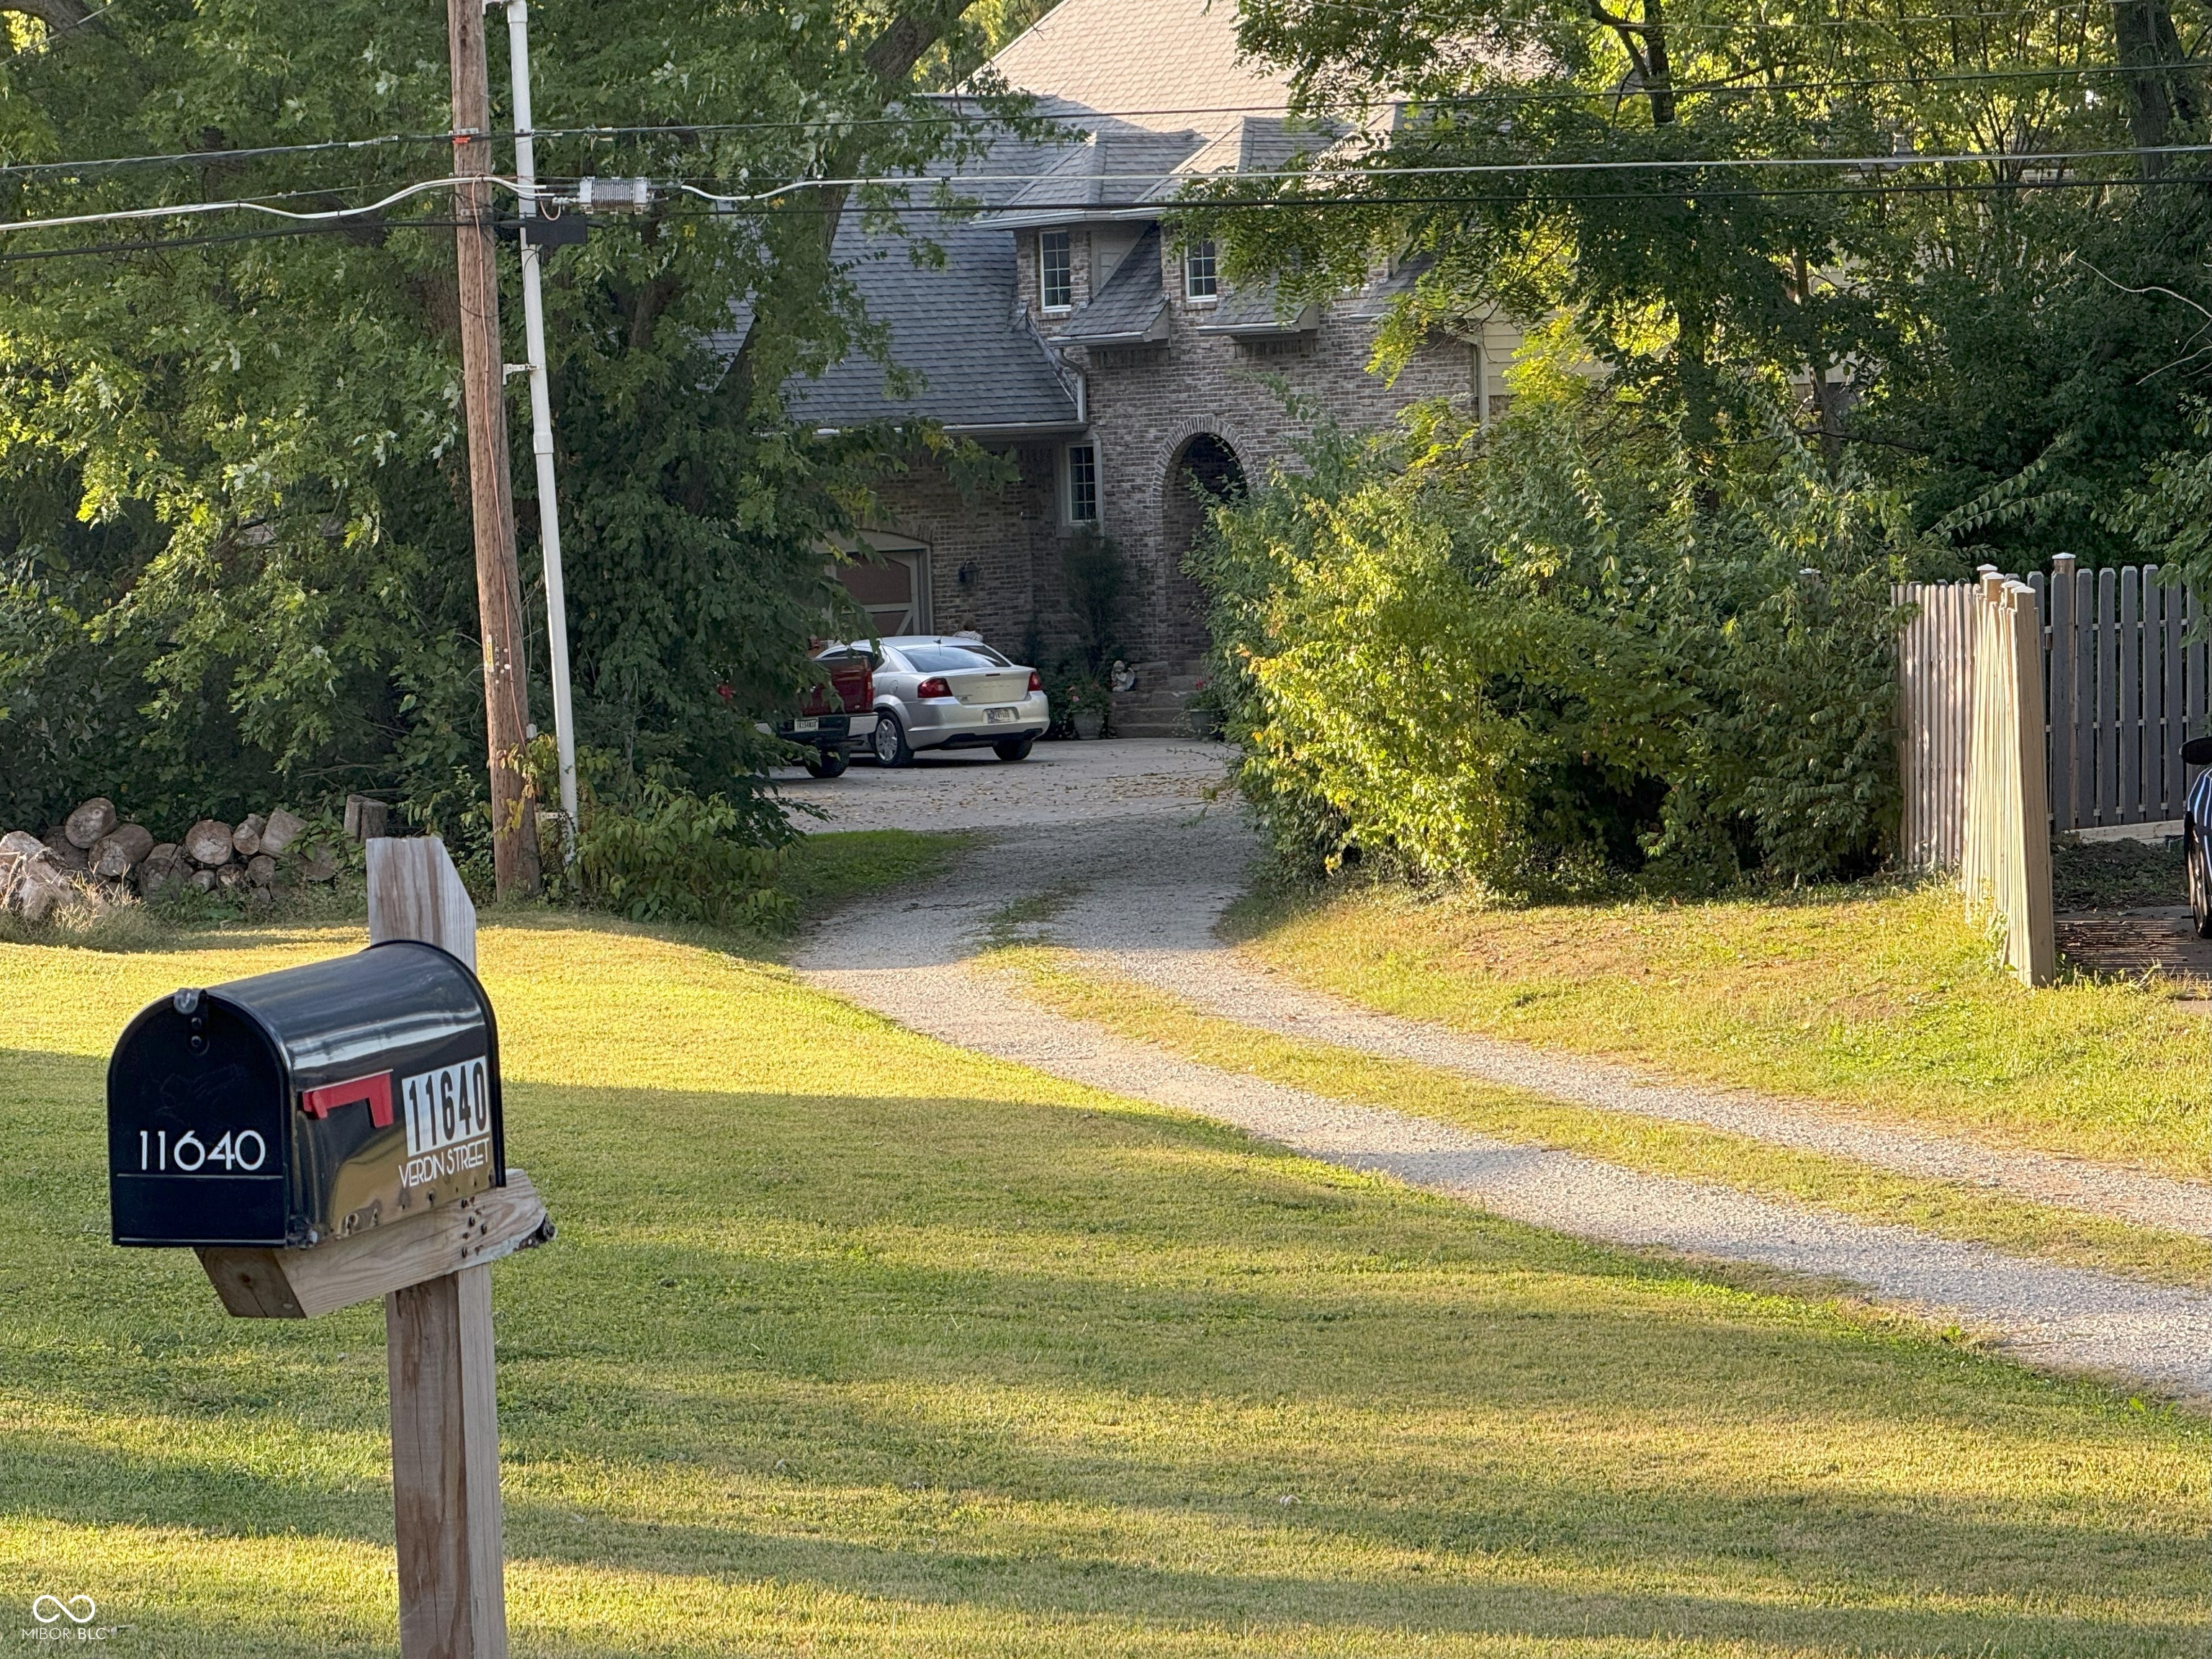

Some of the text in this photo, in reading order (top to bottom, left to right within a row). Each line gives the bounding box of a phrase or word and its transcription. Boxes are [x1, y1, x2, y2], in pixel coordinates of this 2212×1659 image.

[409, 1061, 487, 1152] 11640
[139, 1129, 266, 1172] 11640
[398, 1137, 490, 1188] VERDIN STREET
